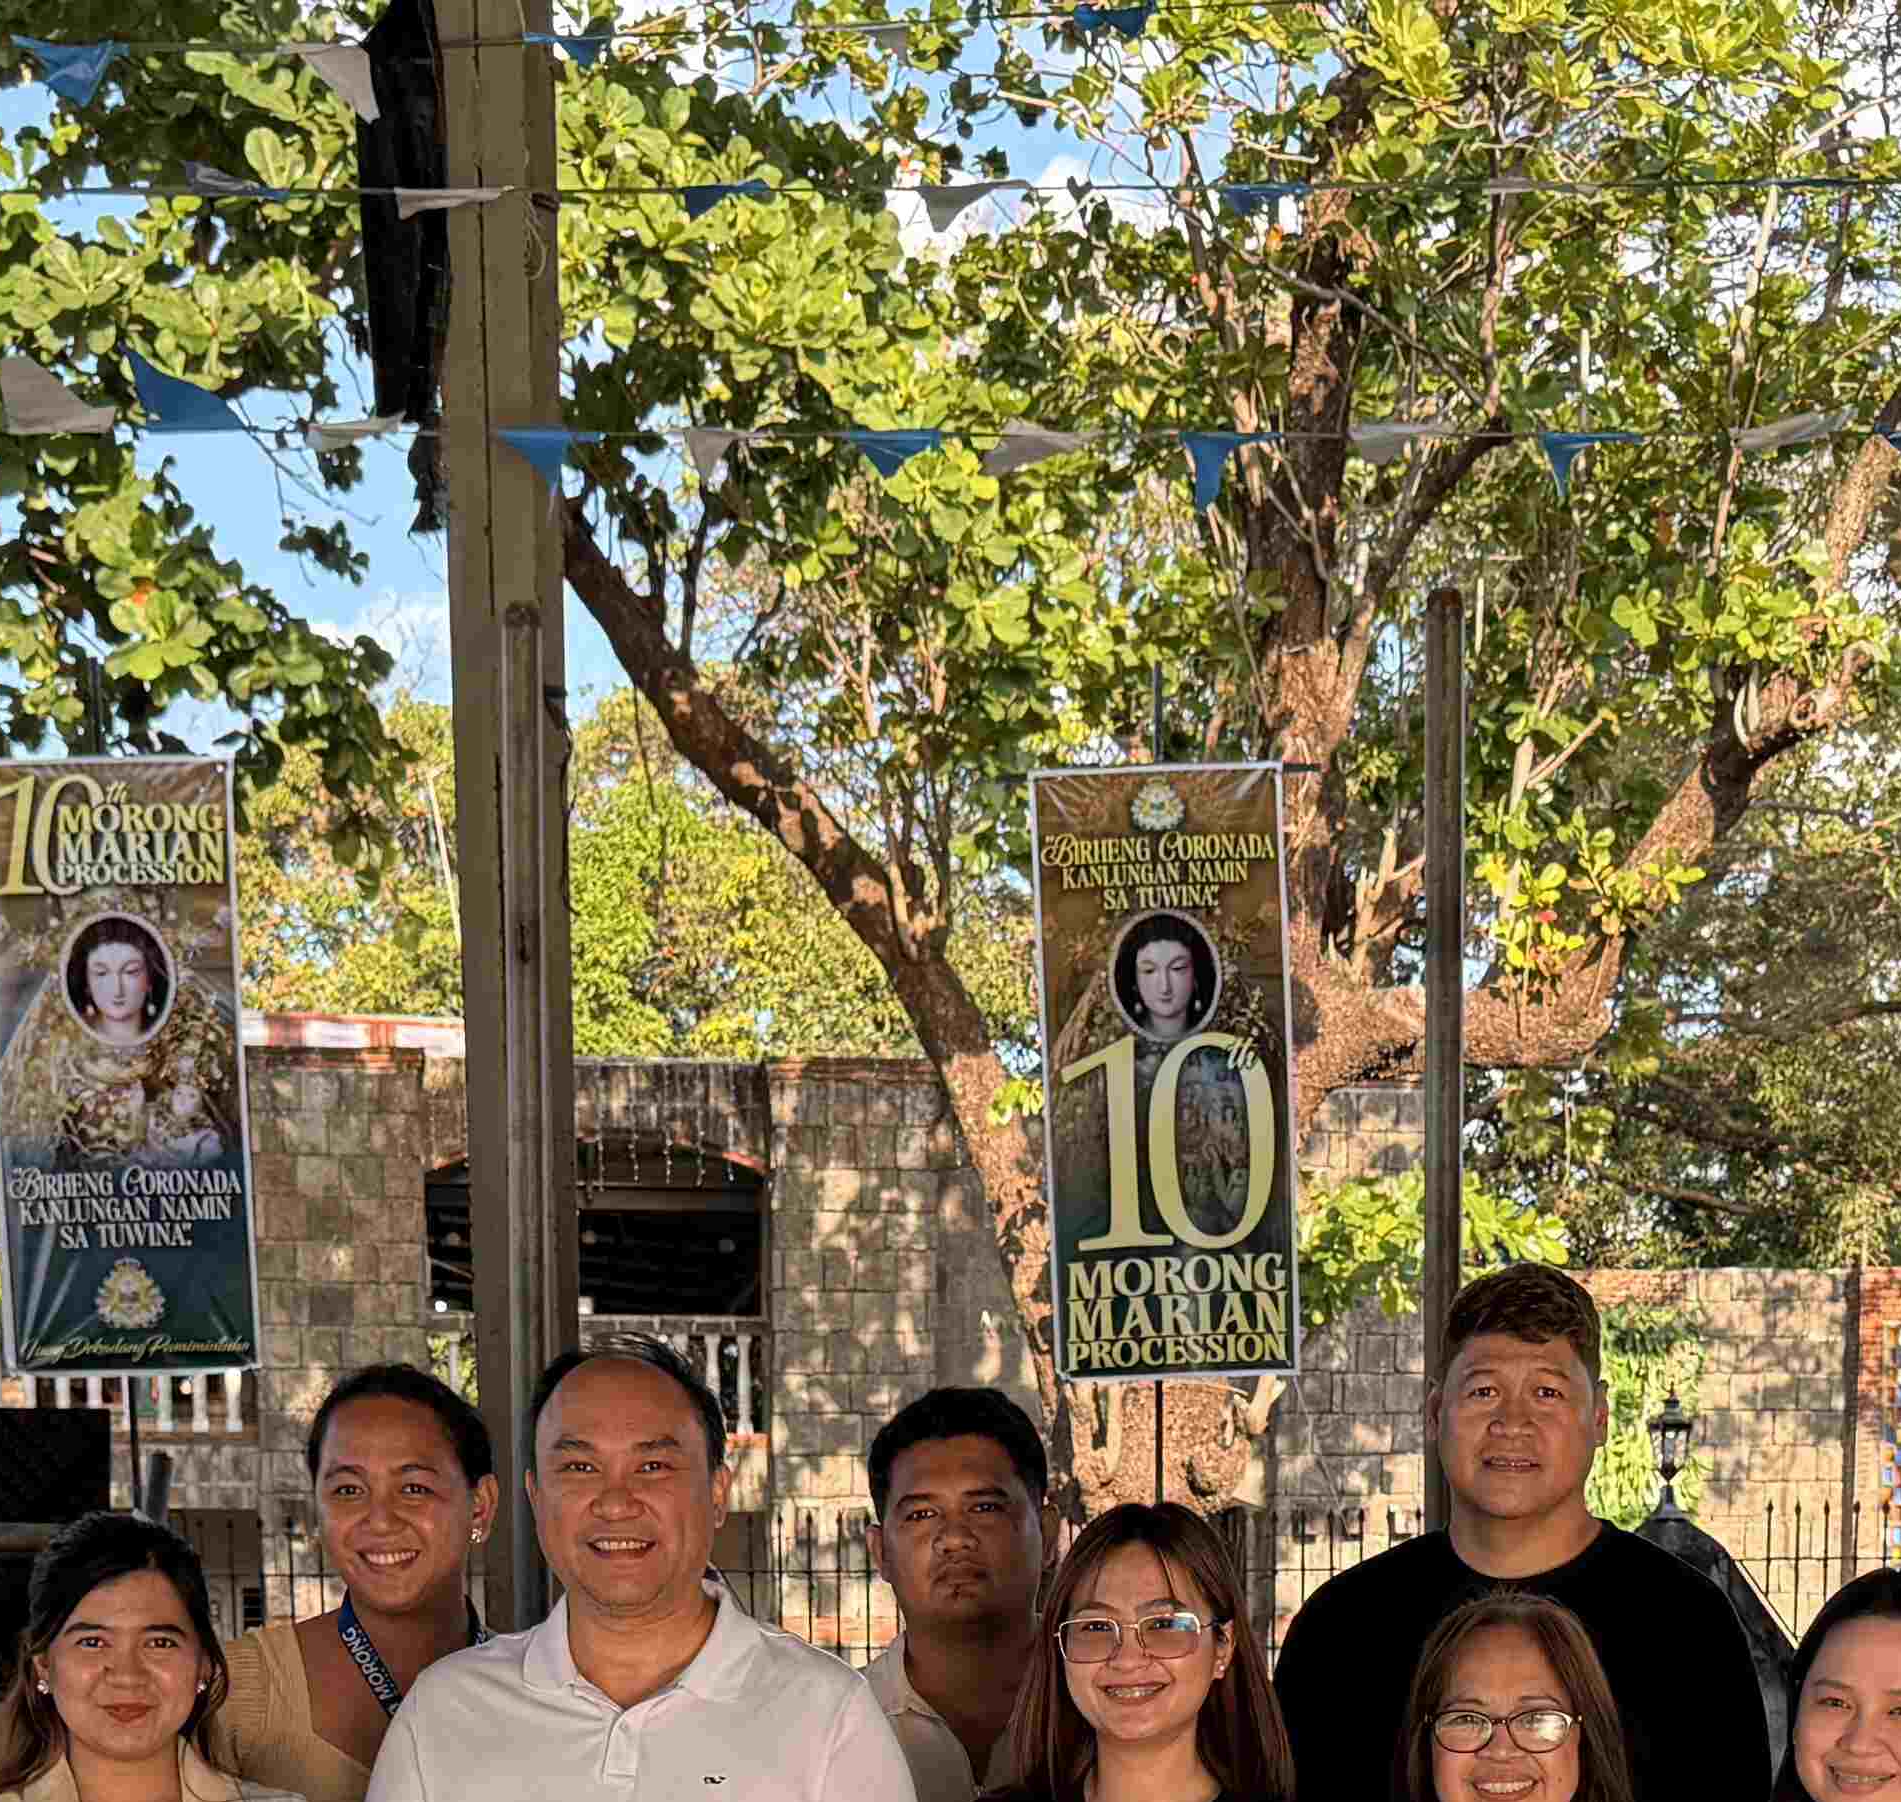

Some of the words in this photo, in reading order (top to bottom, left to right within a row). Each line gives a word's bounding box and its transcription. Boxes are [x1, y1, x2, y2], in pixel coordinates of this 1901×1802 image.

[57, 802, 224, 834] MORONG
[58, 831, 225, 865] MARIAN
[1158, 831, 1275, 862] CORONADA
[57, 861, 225, 885] PROCESSION
[1062, 862, 1180, 890] KANLUNGAN
[1187, 860, 1249, 883] NAMIN
[1103, 888, 1129, 911] SA
[121, 1165, 242, 1197] CORONADA
[19, 1196, 156, 1225] KANLUNGAN
[159, 1195, 233, 1221] NAMIN
[59, 1224, 89, 1249] SA
[1066, 1253, 1286, 1301] MORONG
[1067, 1290, 1287, 1342] MARIAN
[1066, 1333, 1288, 1372] PROCESSION
